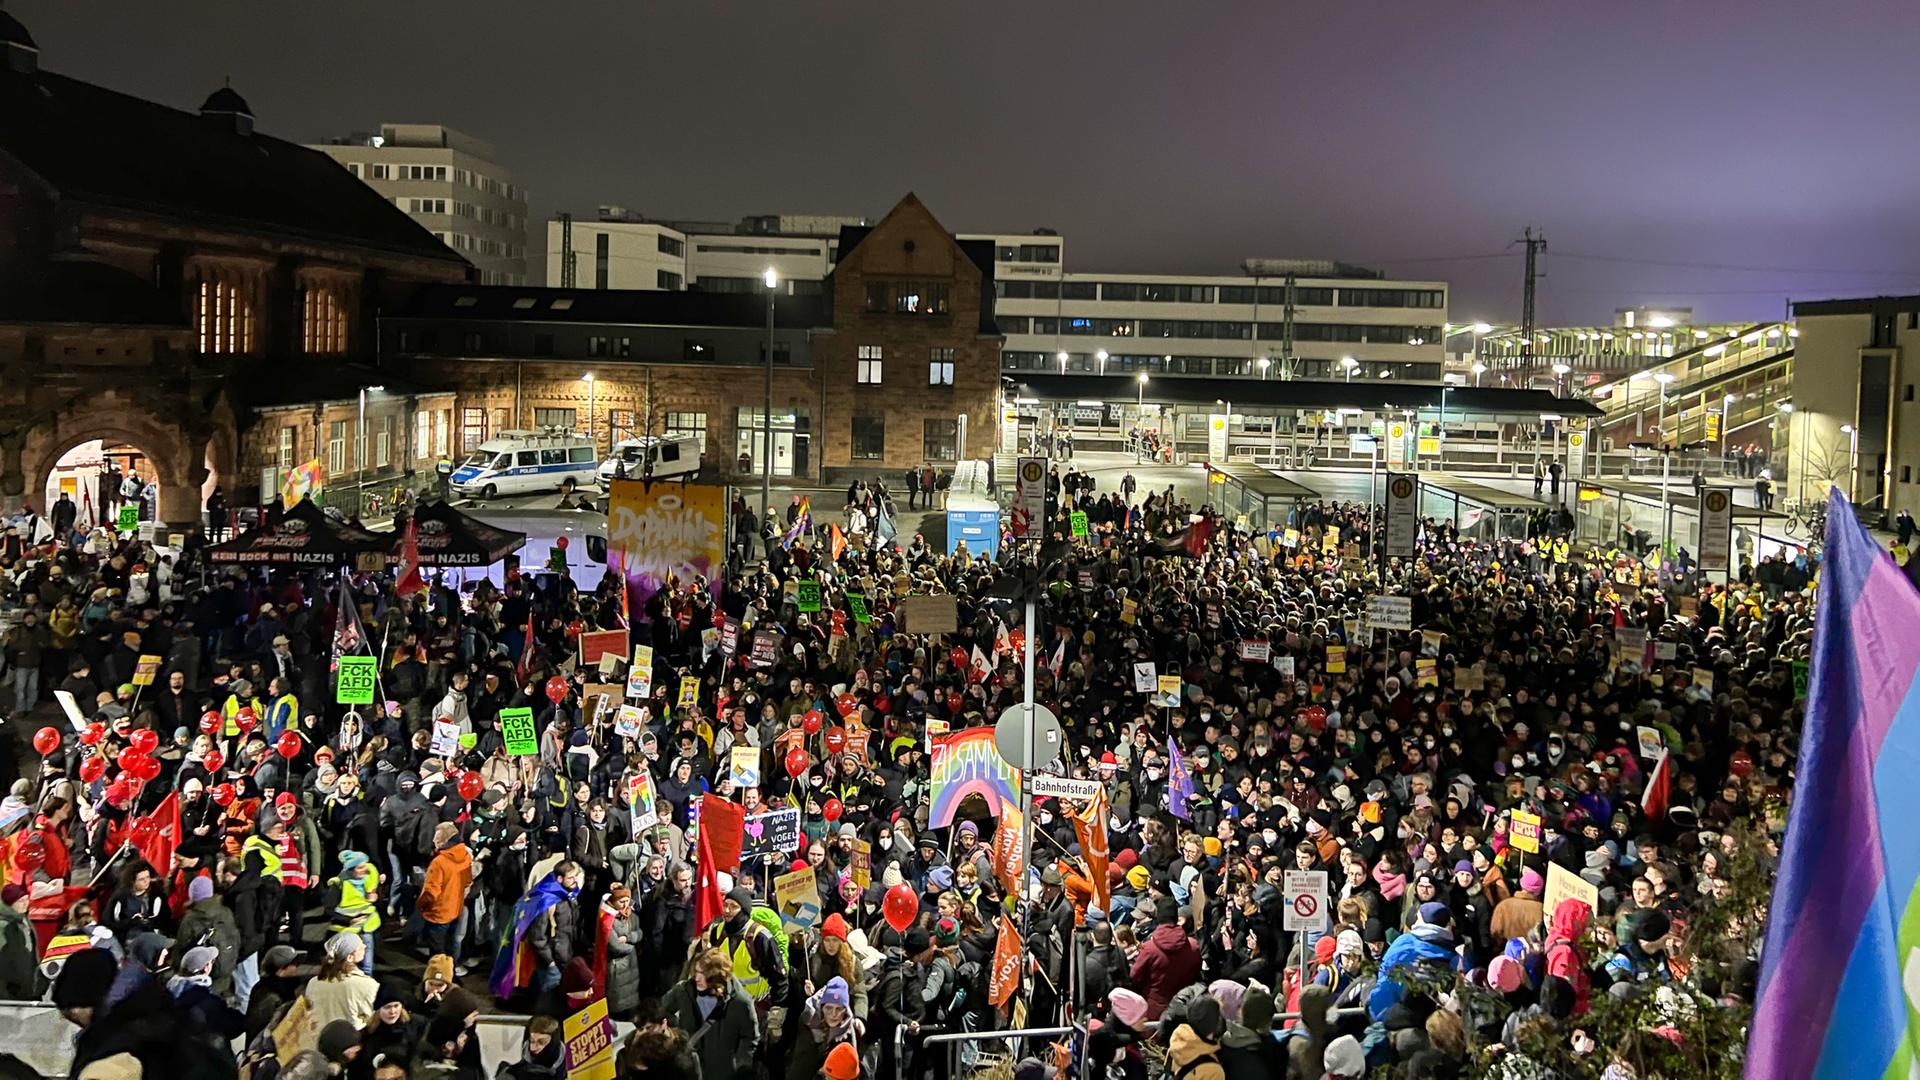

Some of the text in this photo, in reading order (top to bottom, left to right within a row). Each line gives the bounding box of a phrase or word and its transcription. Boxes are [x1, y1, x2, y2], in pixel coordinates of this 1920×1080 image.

[211, 552, 237, 561] KEIN
[239, 552, 269, 561] BOCK
[293, 553, 334, 563] NAZIS
[438, 553, 480, 563] NAZIS
[799, 593, 819, 601] AFD
[341, 665, 372, 677] FCK
[340, 676, 373, 687] AFD
[502, 717, 532, 729] FCK
[506, 728, 533, 740] AFD
[1035, 780, 1097, 796] Bahnhofstraße
[771, 812, 796, 826] NAZIS
[775, 825, 788, 833] den
[770, 831, 797, 844] VOGEL
[569, 1021, 604, 1053] STOPPT
[572, 1047, 589, 1067] DIE
[589, 1034, 607, 1056] AFD
